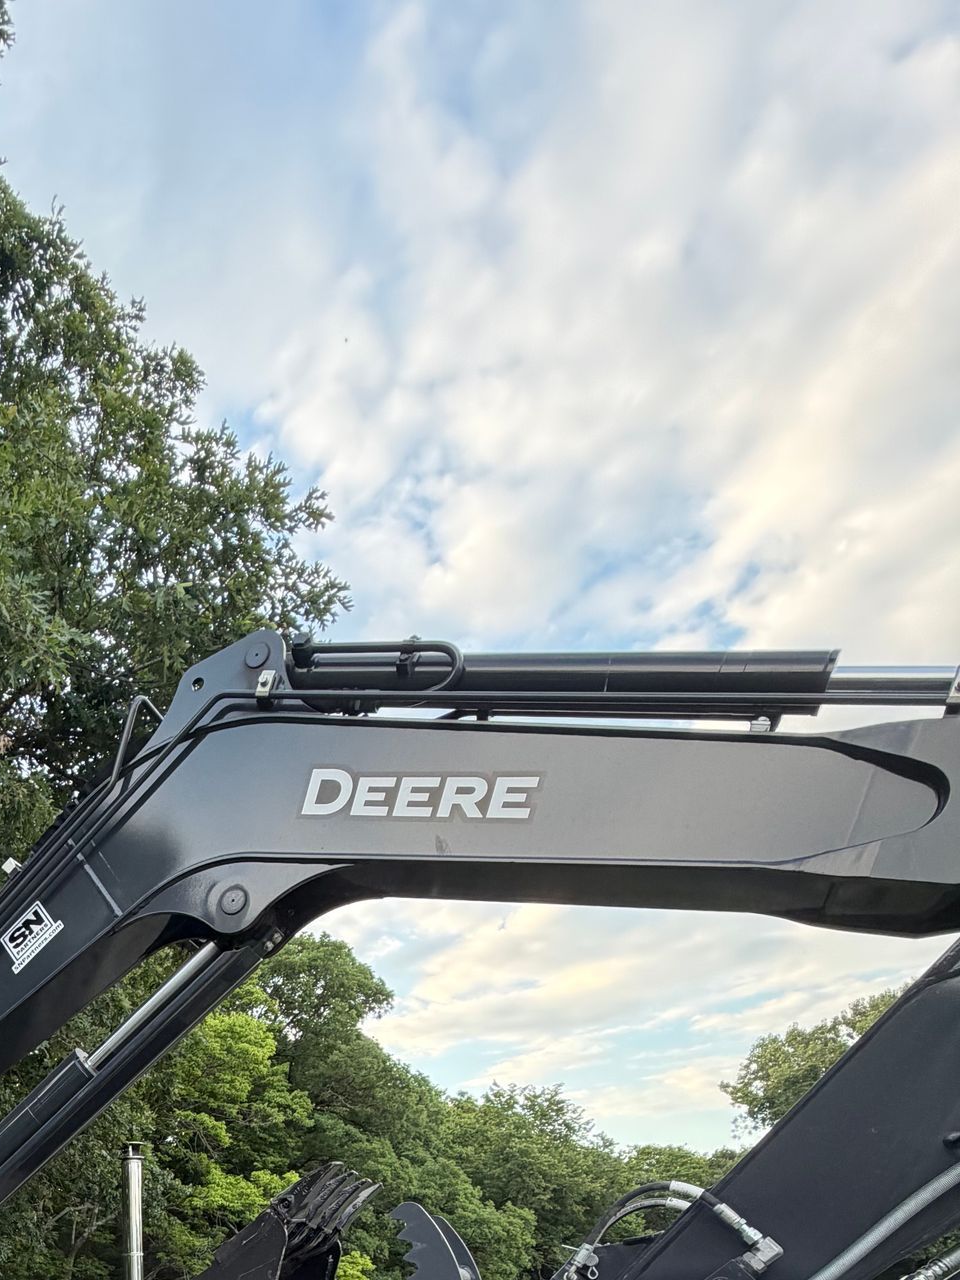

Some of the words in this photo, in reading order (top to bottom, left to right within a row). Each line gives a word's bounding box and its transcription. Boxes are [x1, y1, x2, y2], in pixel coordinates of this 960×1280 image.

[301, 768, 540, 819] DEERE
[8, 909, 46, 949] SN
[16, 923, 49, 956] PARTNERS
